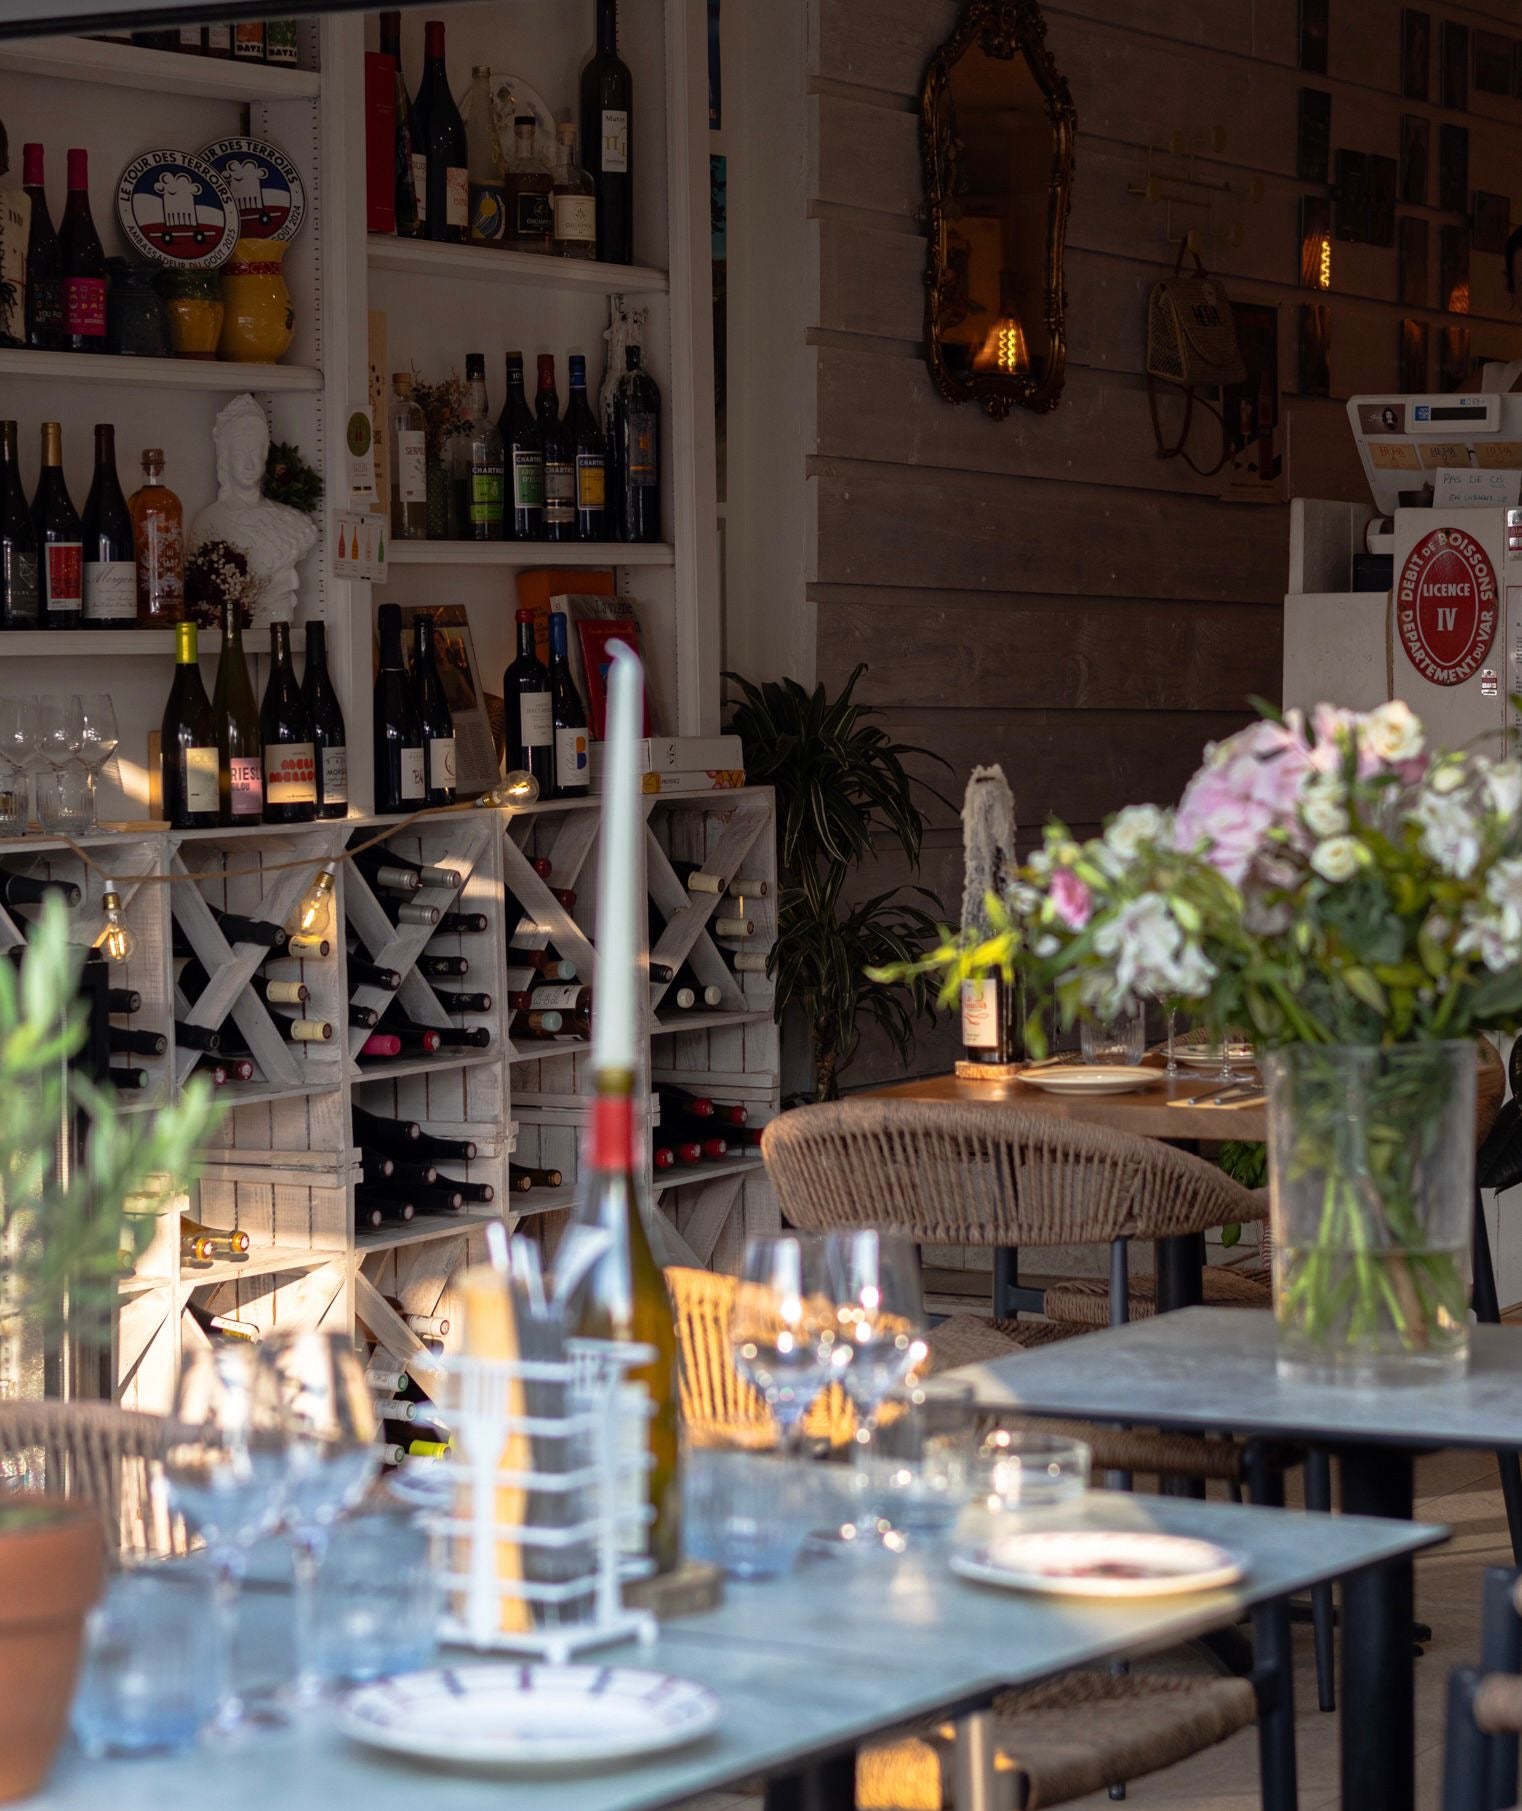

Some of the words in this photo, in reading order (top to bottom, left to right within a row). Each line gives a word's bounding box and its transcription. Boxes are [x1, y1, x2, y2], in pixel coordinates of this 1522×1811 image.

[153, 152, 176, 164] DES
[220, 141, 243, 154] DES
[246, 142, 299, 184] TERROIRS
[124, 159, 151, 184] TOUR
[180, 155, 232, 205] TERROIRS
[120, 188, 131, 202] LE
[289, 206, 301, 226] 2024
[127, 225, 186, 270] AMBASSADEUR
[222, 228, 236, 250] 2025
[1401, 555, 1424, 601] DEBIT
[1422, 542, 1435, 557] DE
[1438, 532, 1493, 601] BOISSONS
[1423, 584, 1471, 596] LICENCE
[1437, 608, 1458, 631] IV
[1477, 611, 1494, 647] VAR
[1402, 611, 1477, 684] DEPARTEMENT
[1475, 644, 1486, 659] DU
